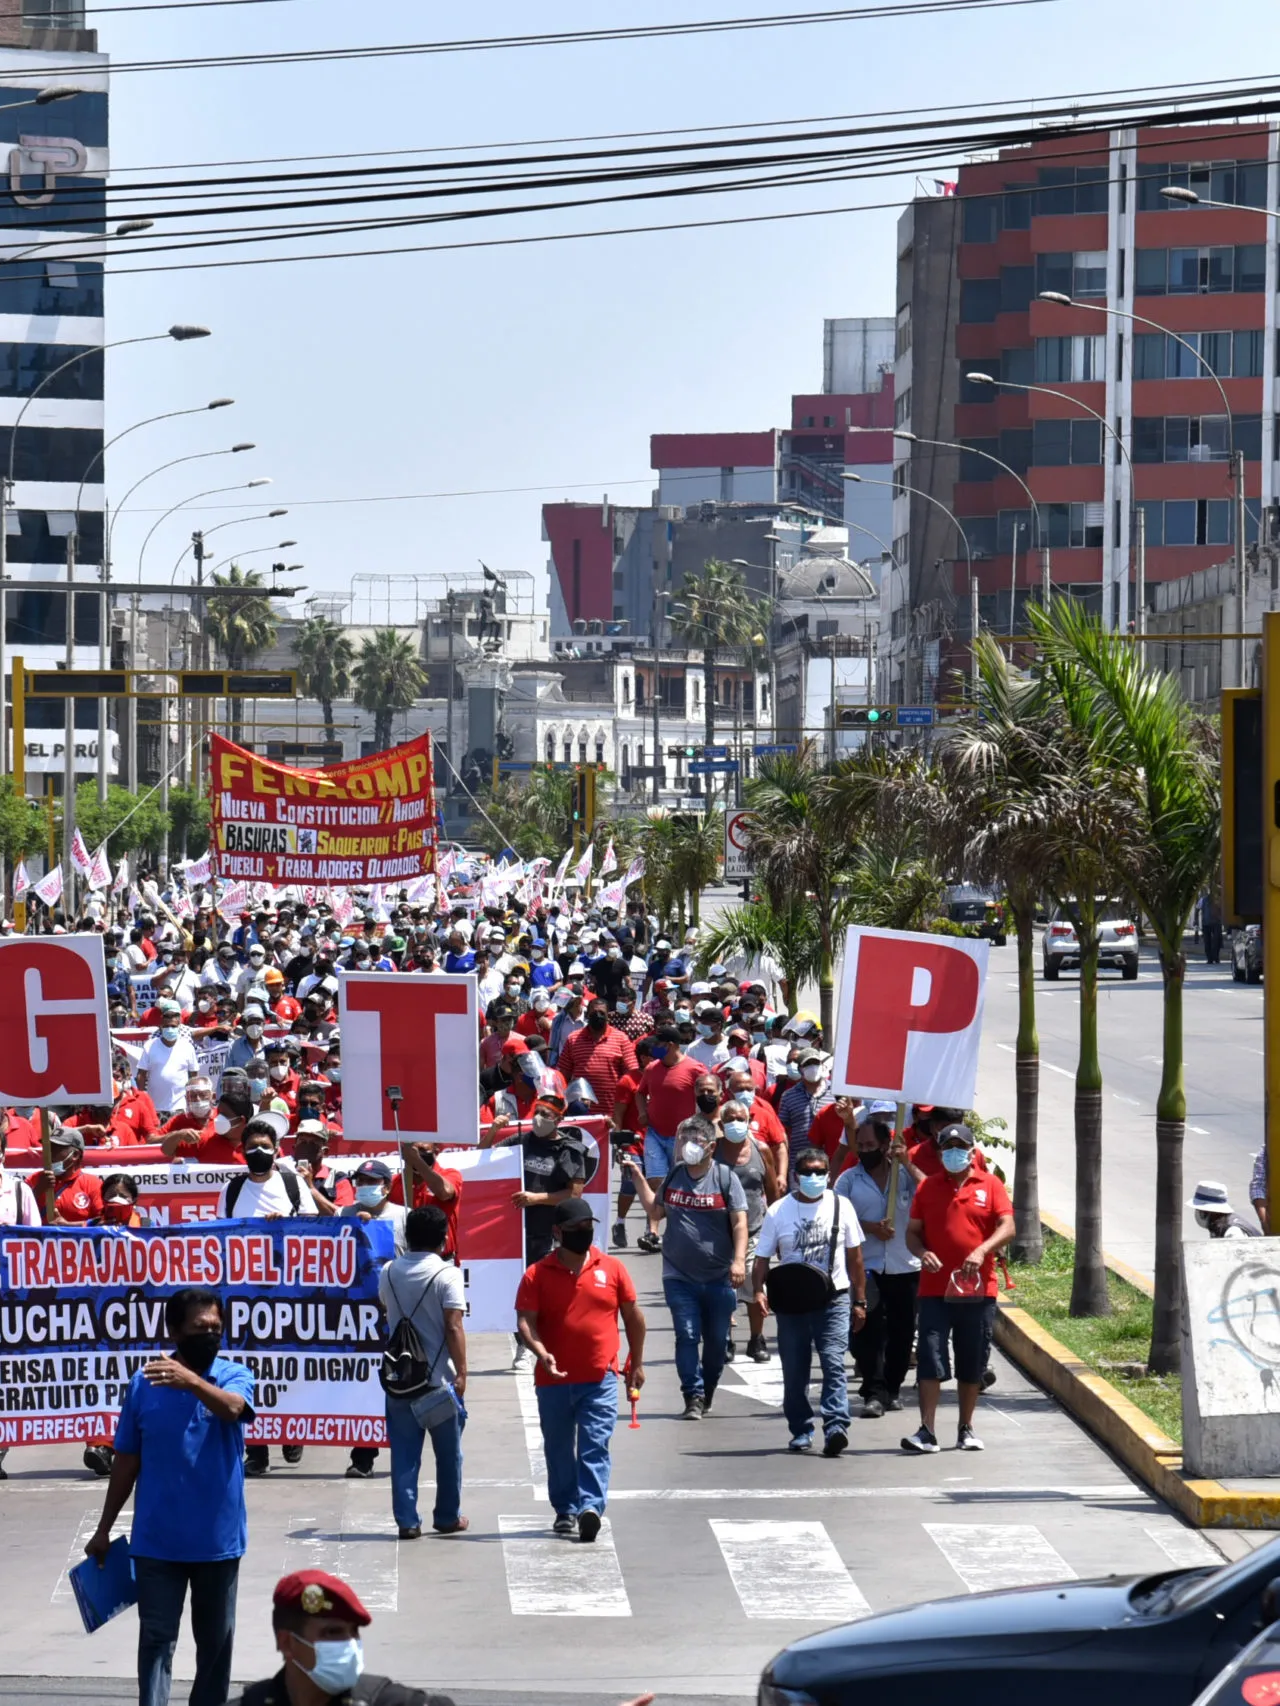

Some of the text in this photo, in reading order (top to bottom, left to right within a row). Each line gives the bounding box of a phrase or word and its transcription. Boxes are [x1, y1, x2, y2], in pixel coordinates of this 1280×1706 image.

[24, 740, 99, 759] EL PRÚ
[845, 936, 979, 1091] P
[346, 981, 468, 1133] T
[173, 1173, 191, 1186] EN
[669, 1192, 715, 1208] HILFIGER
[3, 1235, 221, 1289] TRABAJADORES
[226, 1233, 280, 1287] DEL
[284, 1225, 356, 1288] PERÚ
[231, 1301, 380, 1343] POPULAR
[62, 1356, 87, 1382] DE
[94, 1356, 121, 1381] LA
[22, 1415, 106, 1444] PERFECTA
[285, 1415, 388, 1444] COLECTIVOS!
